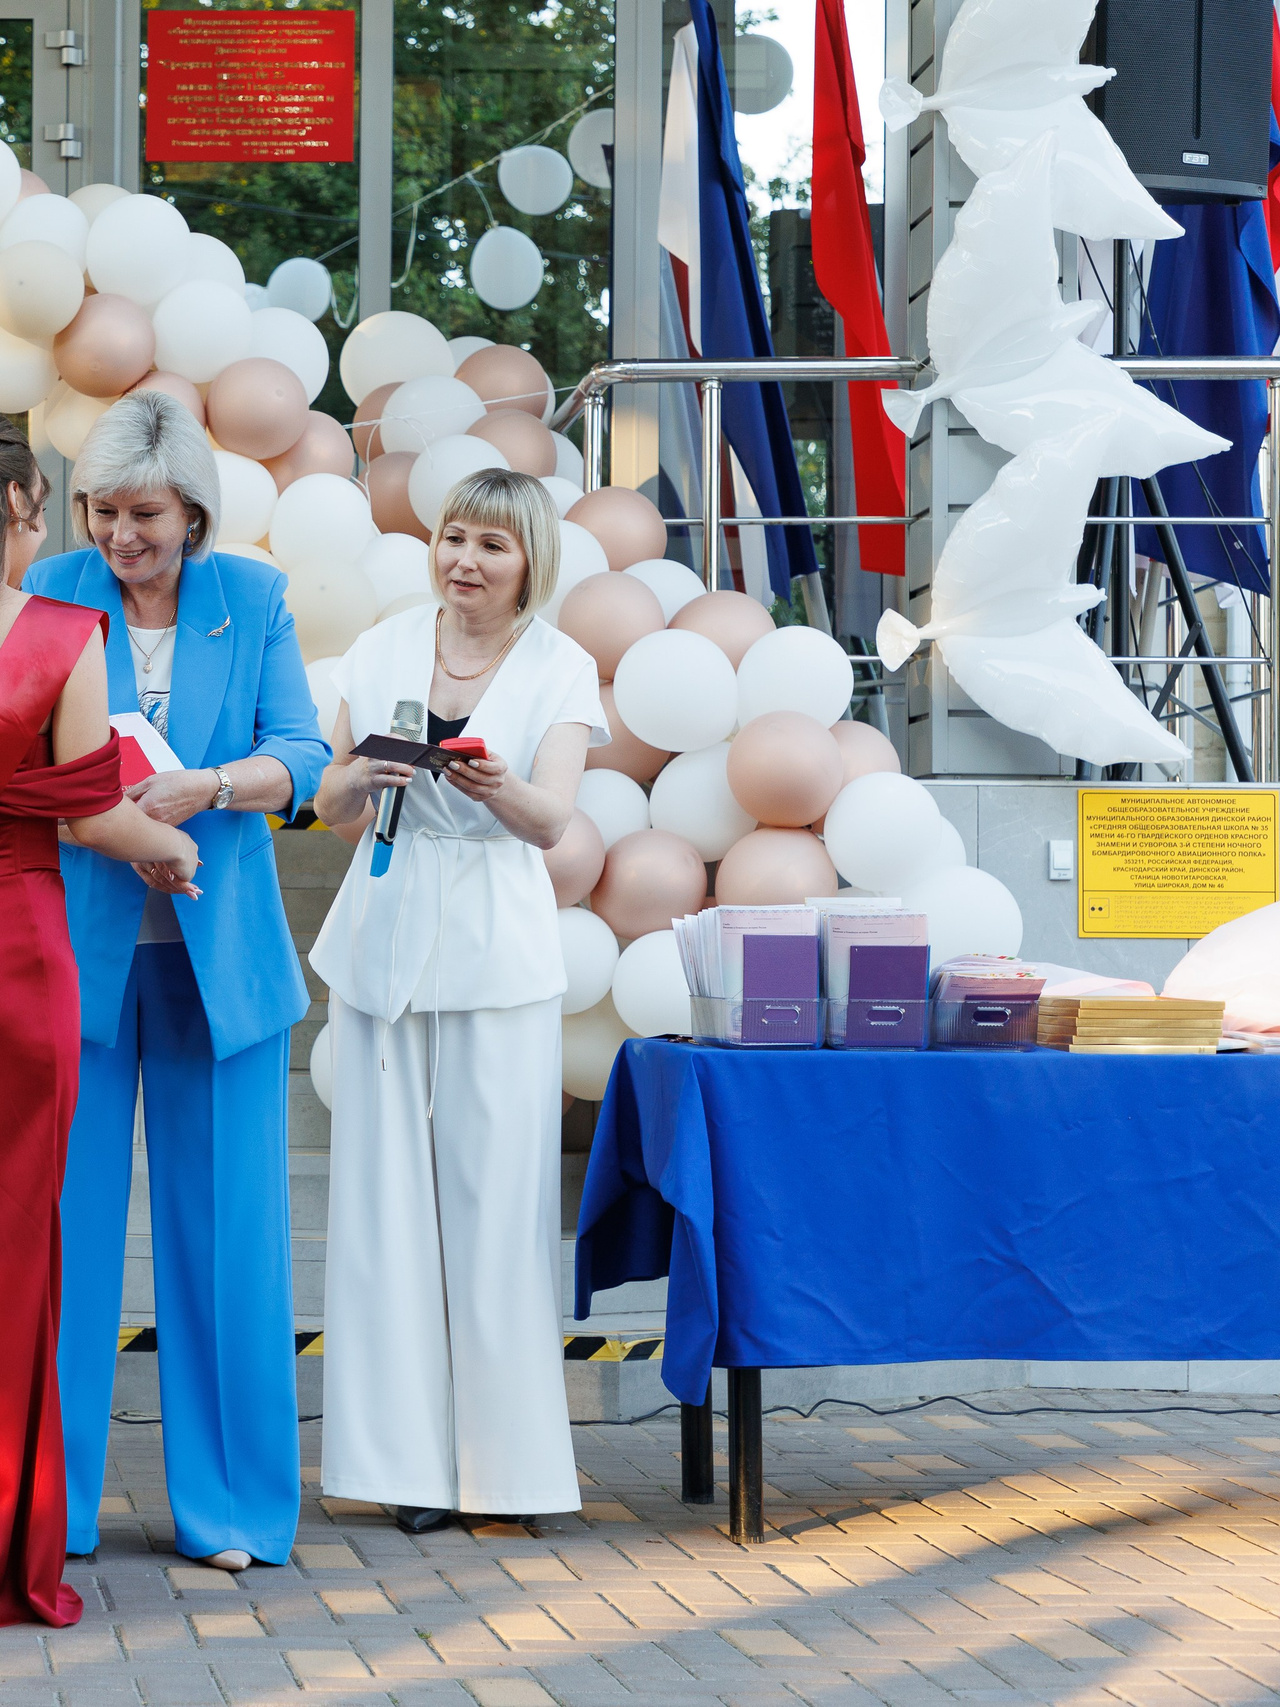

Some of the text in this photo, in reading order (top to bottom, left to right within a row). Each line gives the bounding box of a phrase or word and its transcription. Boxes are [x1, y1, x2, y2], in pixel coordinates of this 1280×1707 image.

[1210, 815, 1246, 823] ДИНСКОЙ
[1137, 832, 1193, 840] ГВАРДЕЙСКОГО
[1176, 850, 1237, 858] АВИАЦИОННОГО
[1188, 866, 1220, 874] ДИНСКОЙ
[1221, 866, 1245, 874] РАЙОН,
